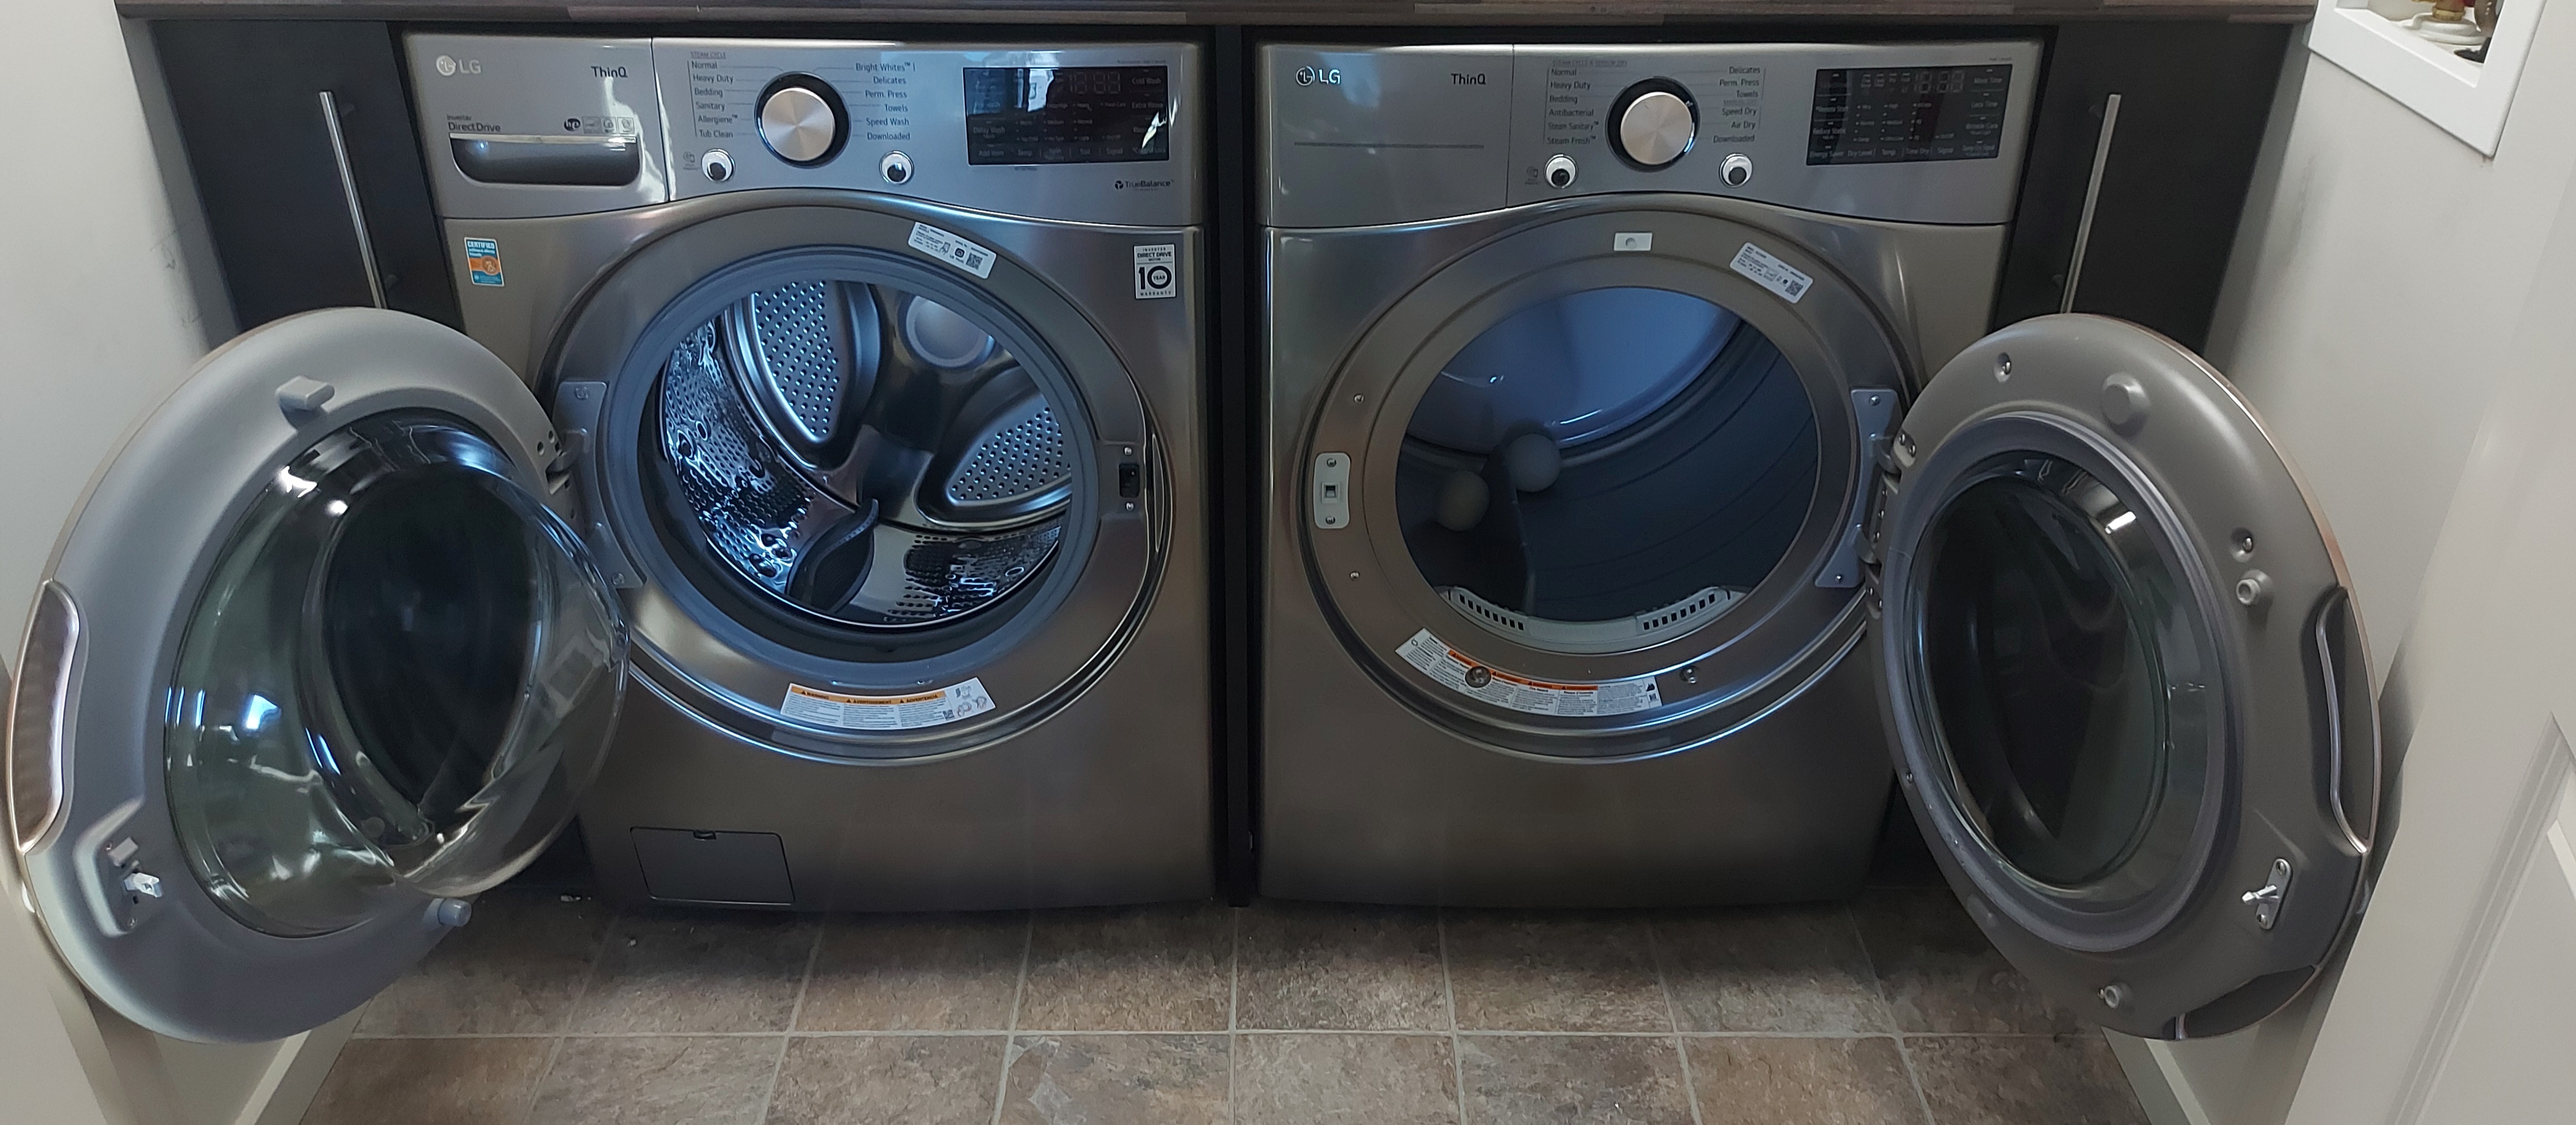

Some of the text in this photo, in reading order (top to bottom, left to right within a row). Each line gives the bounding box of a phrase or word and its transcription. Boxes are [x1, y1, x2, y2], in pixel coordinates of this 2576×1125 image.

[458, 59, 481, 74] LG
[691, 61, 718, 69] Normal
[856, 63, 878, 73] Bright
[591, 66, 628, 78] ThinQ
[693, 74, 733, 84] Heavy Duty
[873, 76, 906, 84] Delicates
[1319, 69, 1341, 85] LG
[1451, 73, 1486, 85] ThinQ
[1550, 81, 1591, 91] Heavy Duty
[695, 87, 723, 98] Bedding
[865, 90, 907, 98] Perm. Press
[1549, 95, 1578, 105] Bedding
[696, 101, 725, 111] Sanitary
[885, 104, 908, 112] Towels
[1722, 107, 1757, 116] Speed Dry
[866, 118, 909, 127] Speed Wash
[1743, 121, 1755, 130] Dry
[699, 129, 711, 138] Tub
[867, 132, 910, 140] Downloaded
[1713, 134, 1755, 143] Downloaded
[467, 241, 495, 249] CERTIFIED
[1139, 265, 1172, 290] 10
